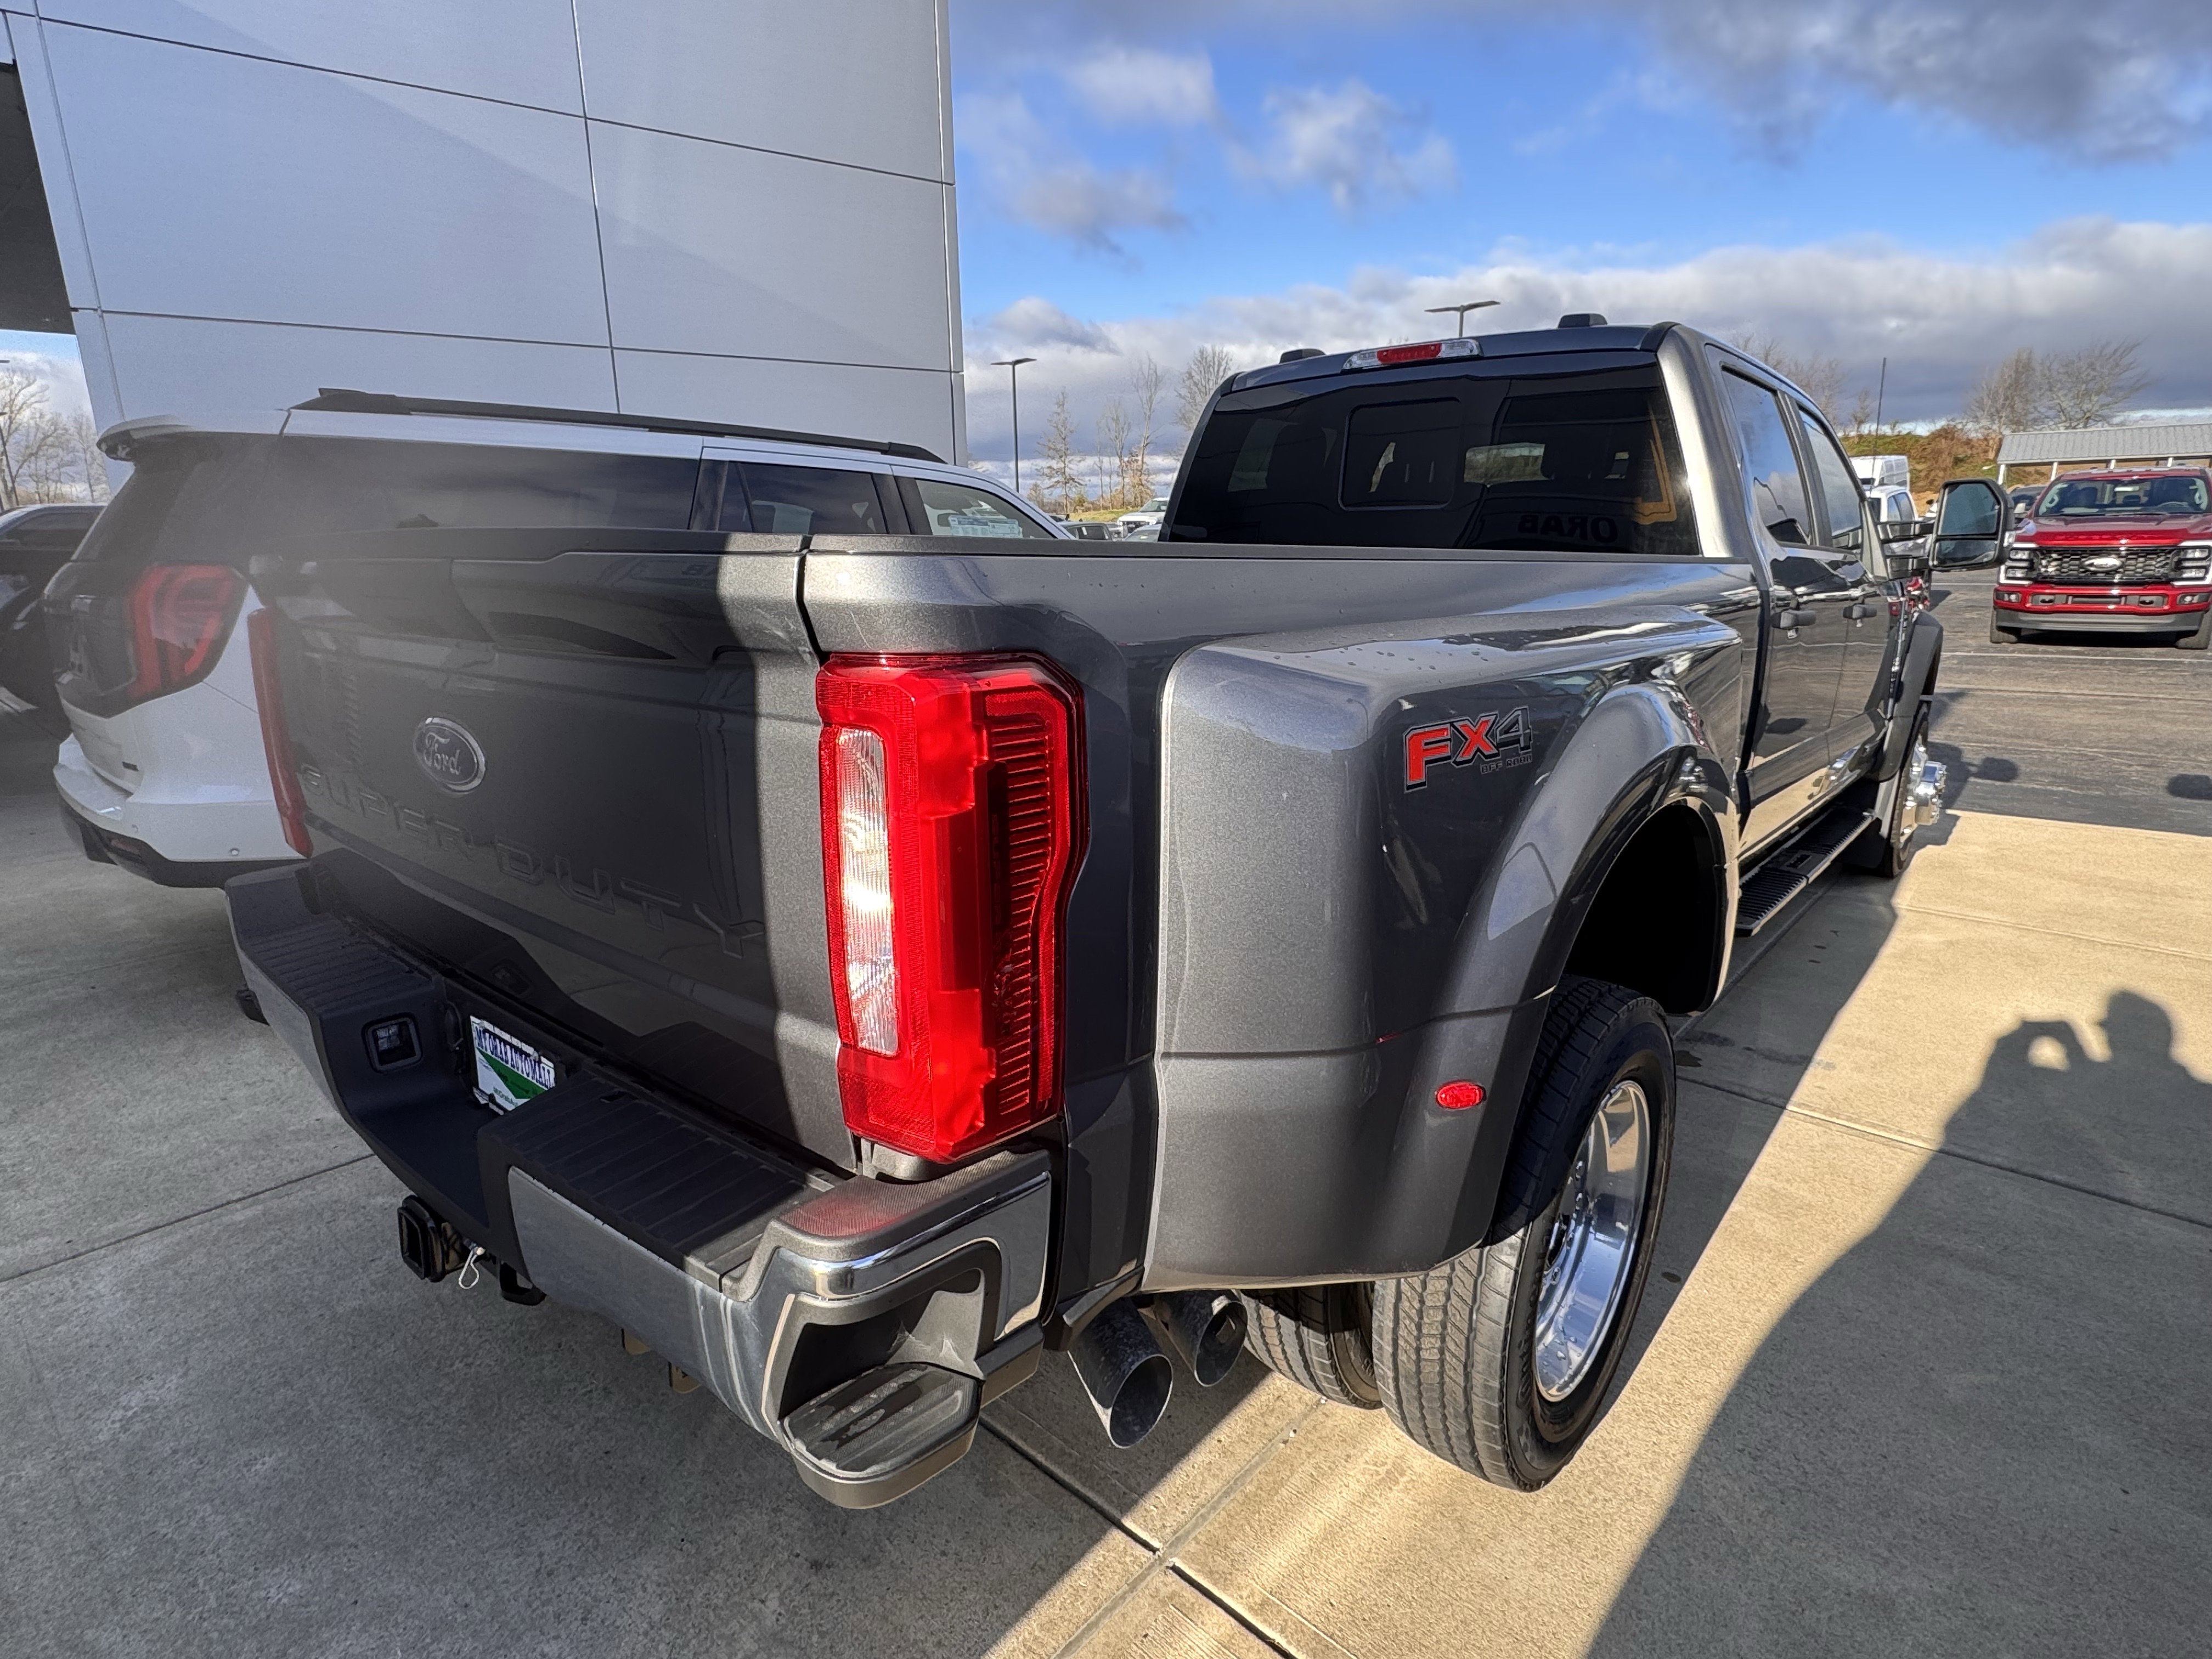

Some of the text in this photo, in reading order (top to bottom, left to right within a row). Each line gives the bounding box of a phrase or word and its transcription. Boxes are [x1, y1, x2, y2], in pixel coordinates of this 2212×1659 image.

[424, 732, 460, 774] Ford
[1403, 706, 1533, 793] FX4
[301, 764, 766, 959] SUPER DUTY
